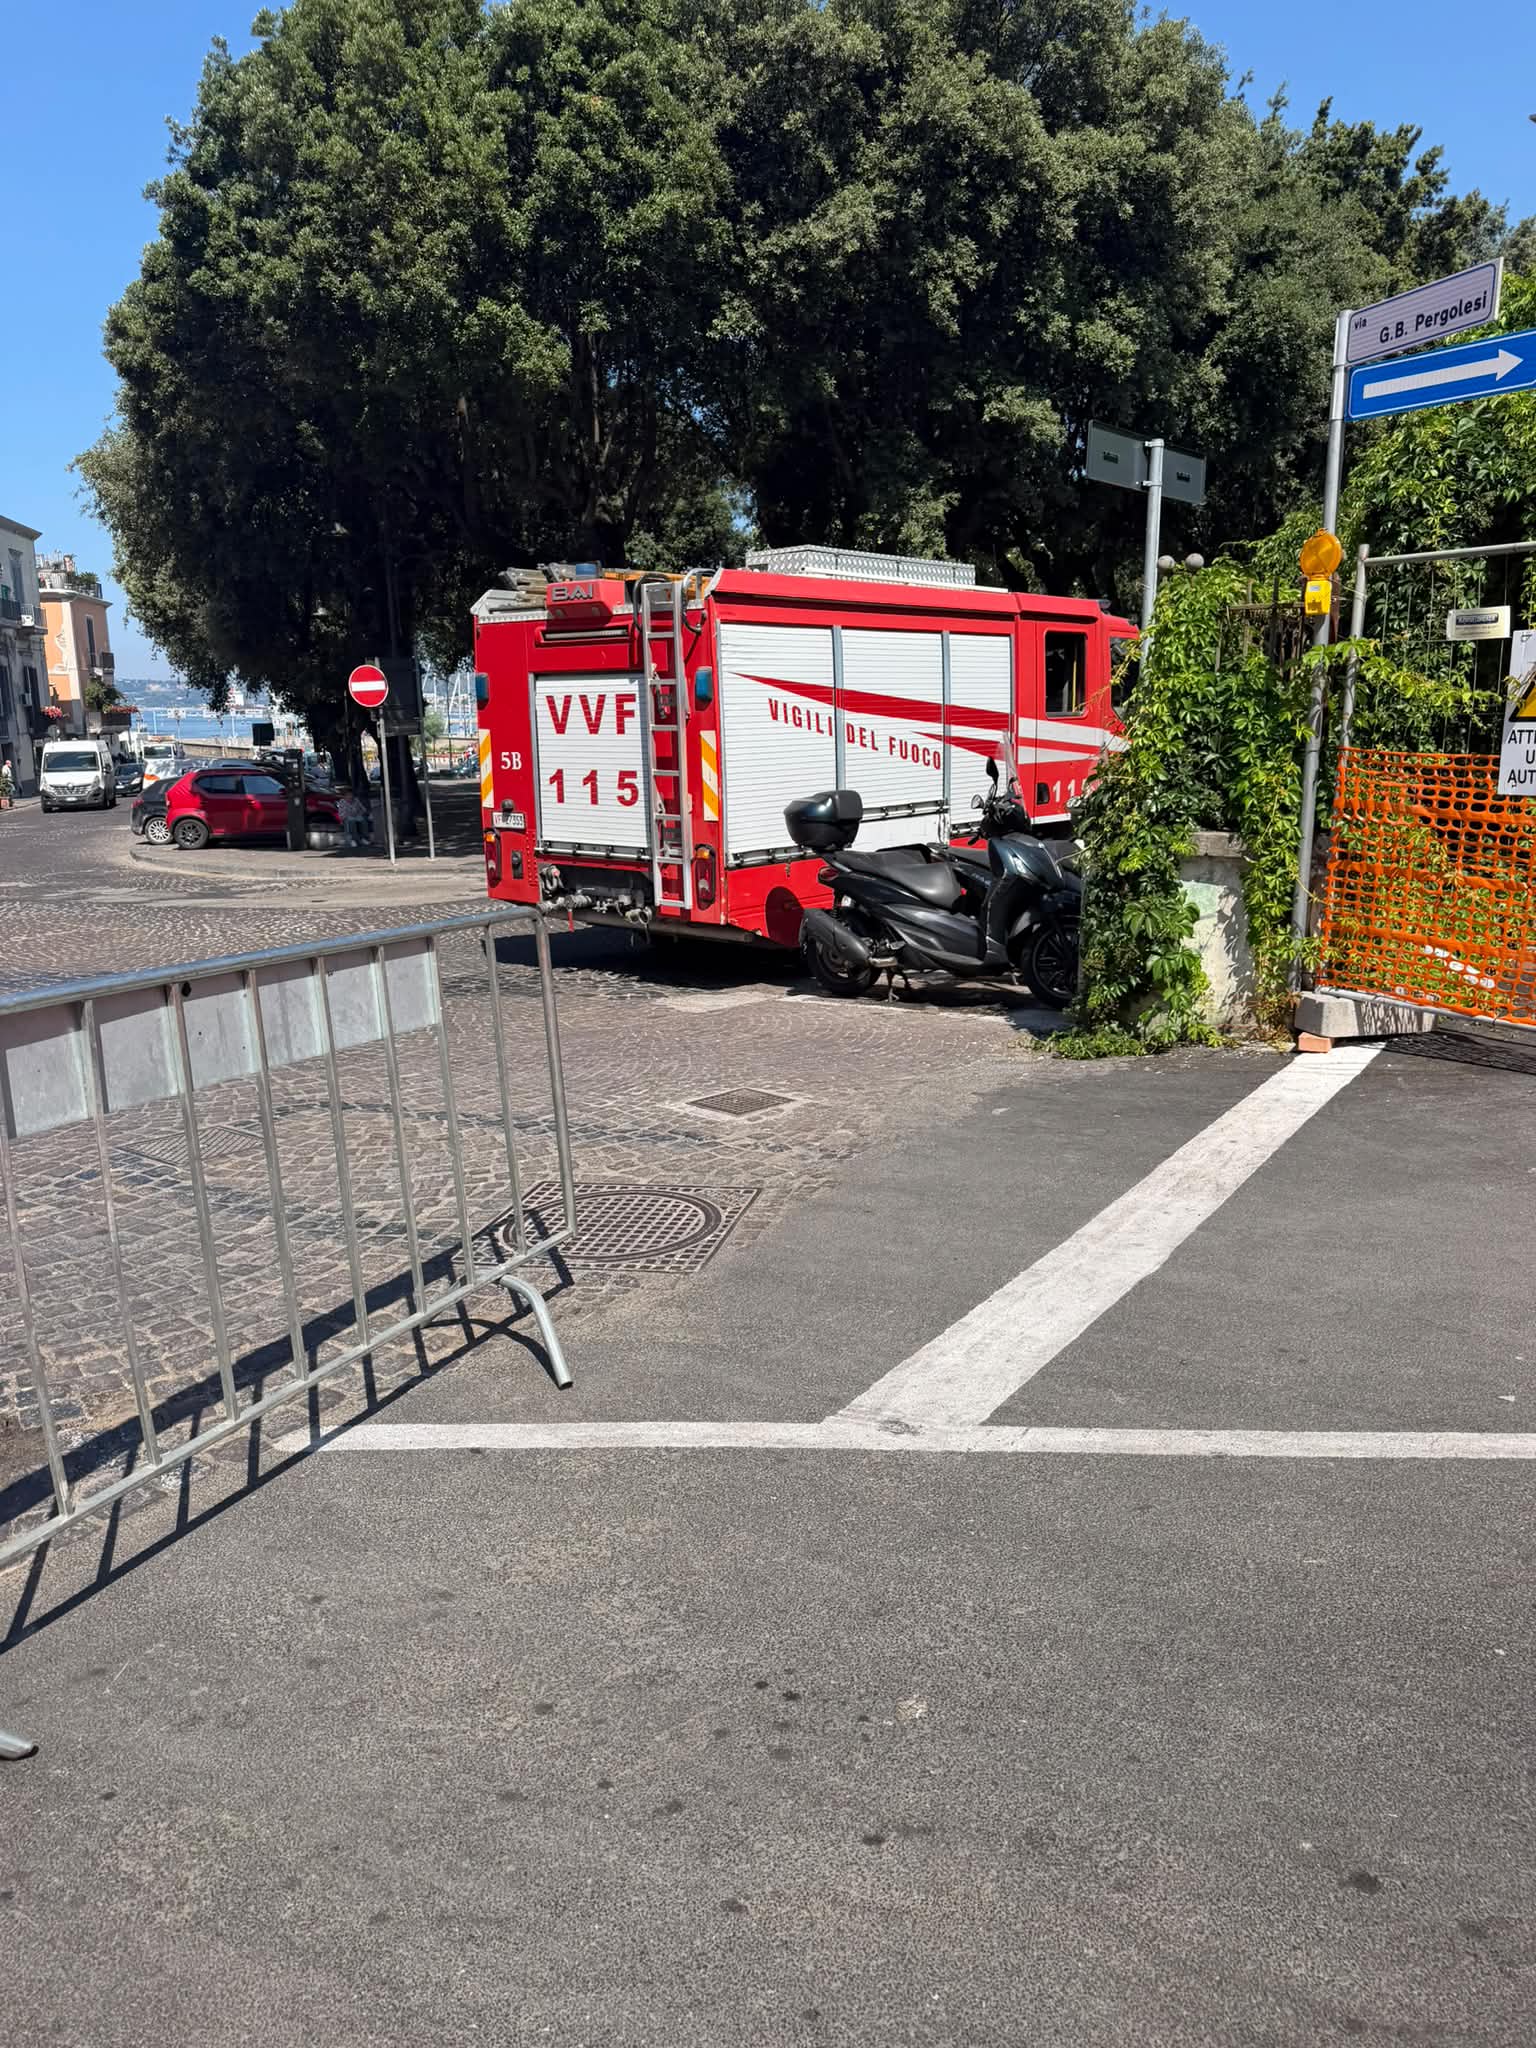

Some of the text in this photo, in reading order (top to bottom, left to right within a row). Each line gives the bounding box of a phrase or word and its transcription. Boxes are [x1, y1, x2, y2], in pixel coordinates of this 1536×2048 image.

[1354, 317, 1367, 330] via
[1379, 290, 1488, 344] G.B. Pergolesi
[551, 583, 594, 601] BAI
[545, 693, 637, 735] VVF
[768, 698, 941, 771] VIGILI DEL FUOCO
[500, 751, 523, 771] 5B
[548, 768, 640, 807] 115
